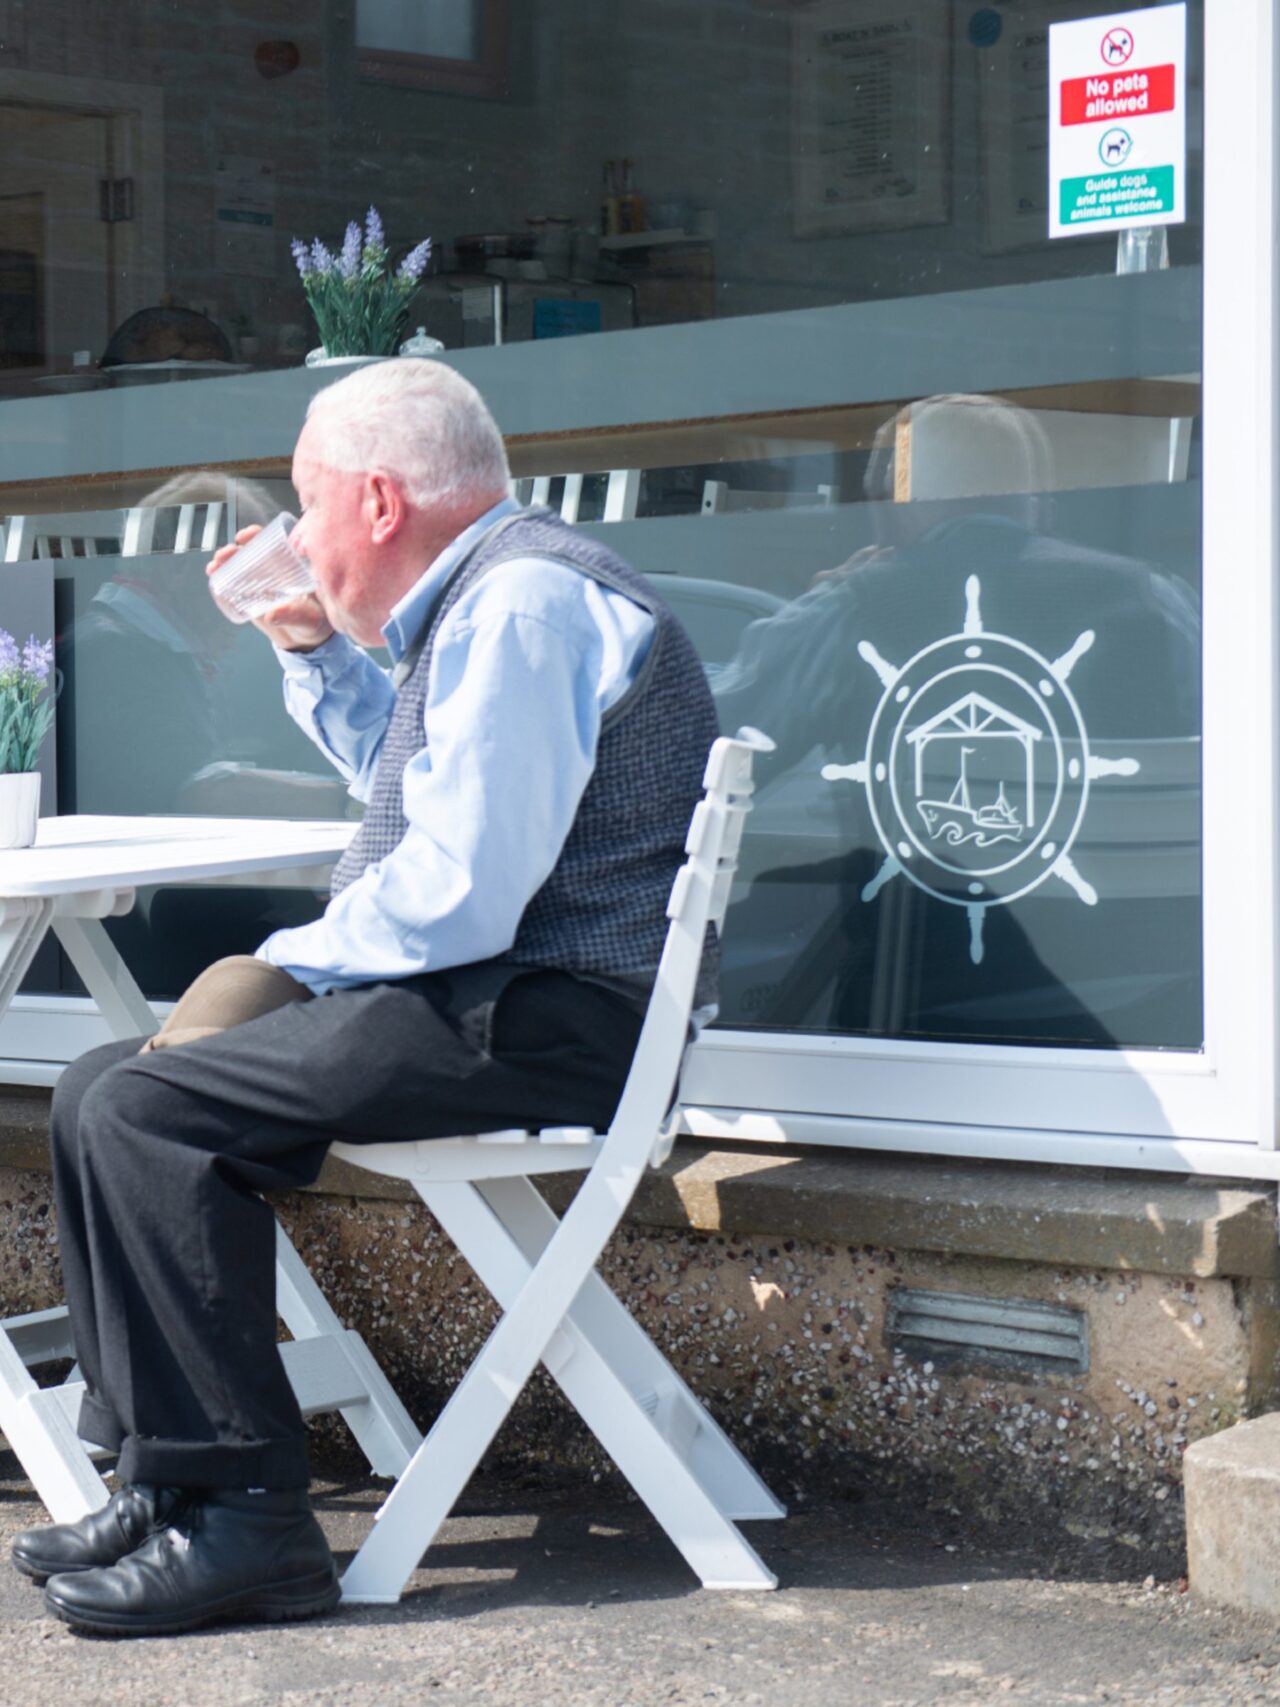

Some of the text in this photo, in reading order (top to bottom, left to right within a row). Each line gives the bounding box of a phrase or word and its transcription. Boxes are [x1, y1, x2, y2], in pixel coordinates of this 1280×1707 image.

[1086, 72, 1148, 98] No pets
[1085, 90, 1148, 118] allowed
[1085, 174, 1147, 193] Guide dogs
[1076, 186, 1157, 207] and assistance
[1070, 199, 1163, 221] animals welcome
